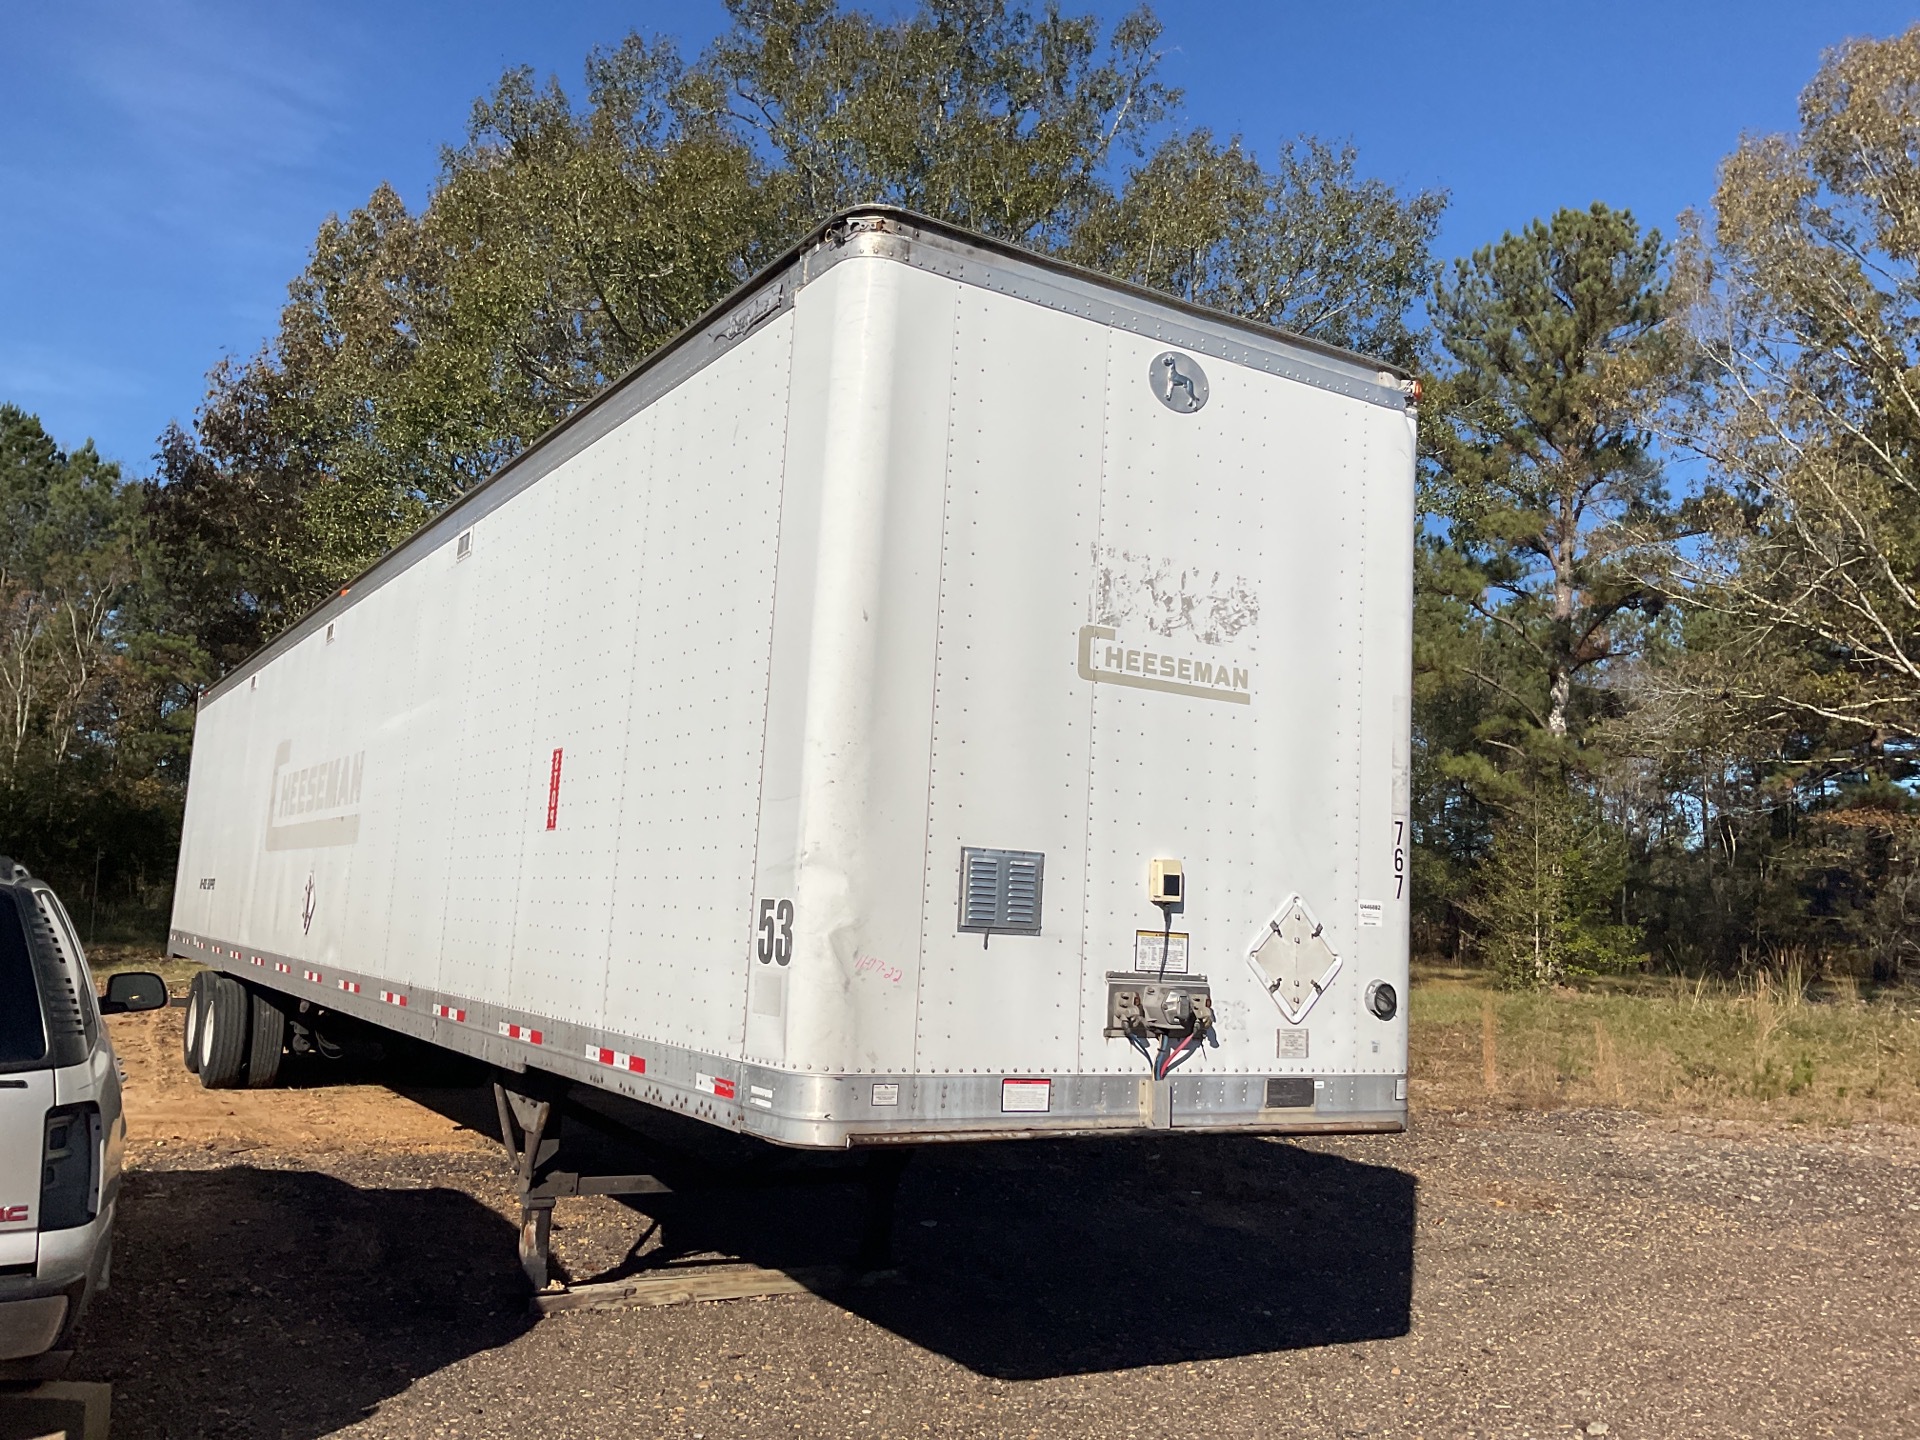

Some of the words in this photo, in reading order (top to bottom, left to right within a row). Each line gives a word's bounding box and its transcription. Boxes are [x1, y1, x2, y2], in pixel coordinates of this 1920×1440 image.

[1078, 625, 1250, 705] CHEESEMAN
[266, 740, 365, 850] CHEESEMAN
[1394, 821, 1404, 899] 767
[757, 898, 795, 967] 53
